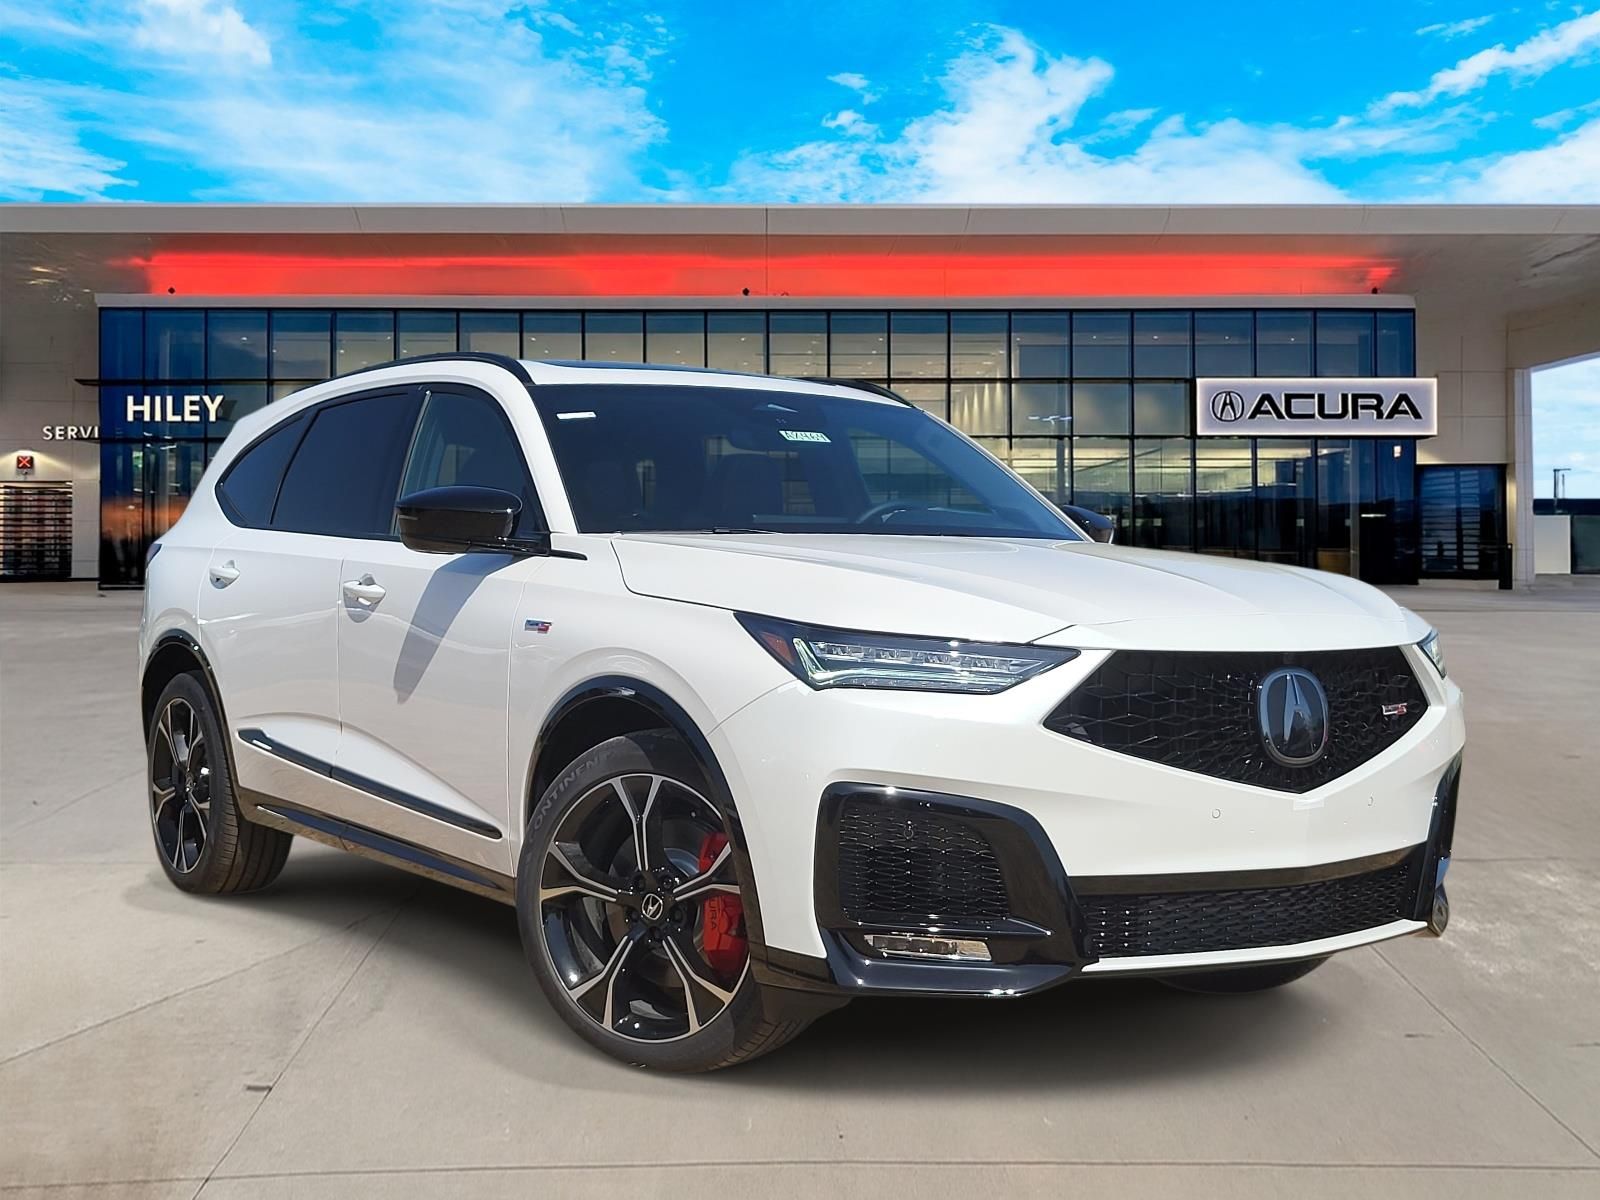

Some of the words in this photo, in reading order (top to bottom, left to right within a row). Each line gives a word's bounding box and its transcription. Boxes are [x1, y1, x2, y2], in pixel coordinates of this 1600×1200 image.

[126, 395, 224, 422] HILEY
[1248, 393, 1423, 420] ACURA
[42, 425, 98, 440] SERVI
